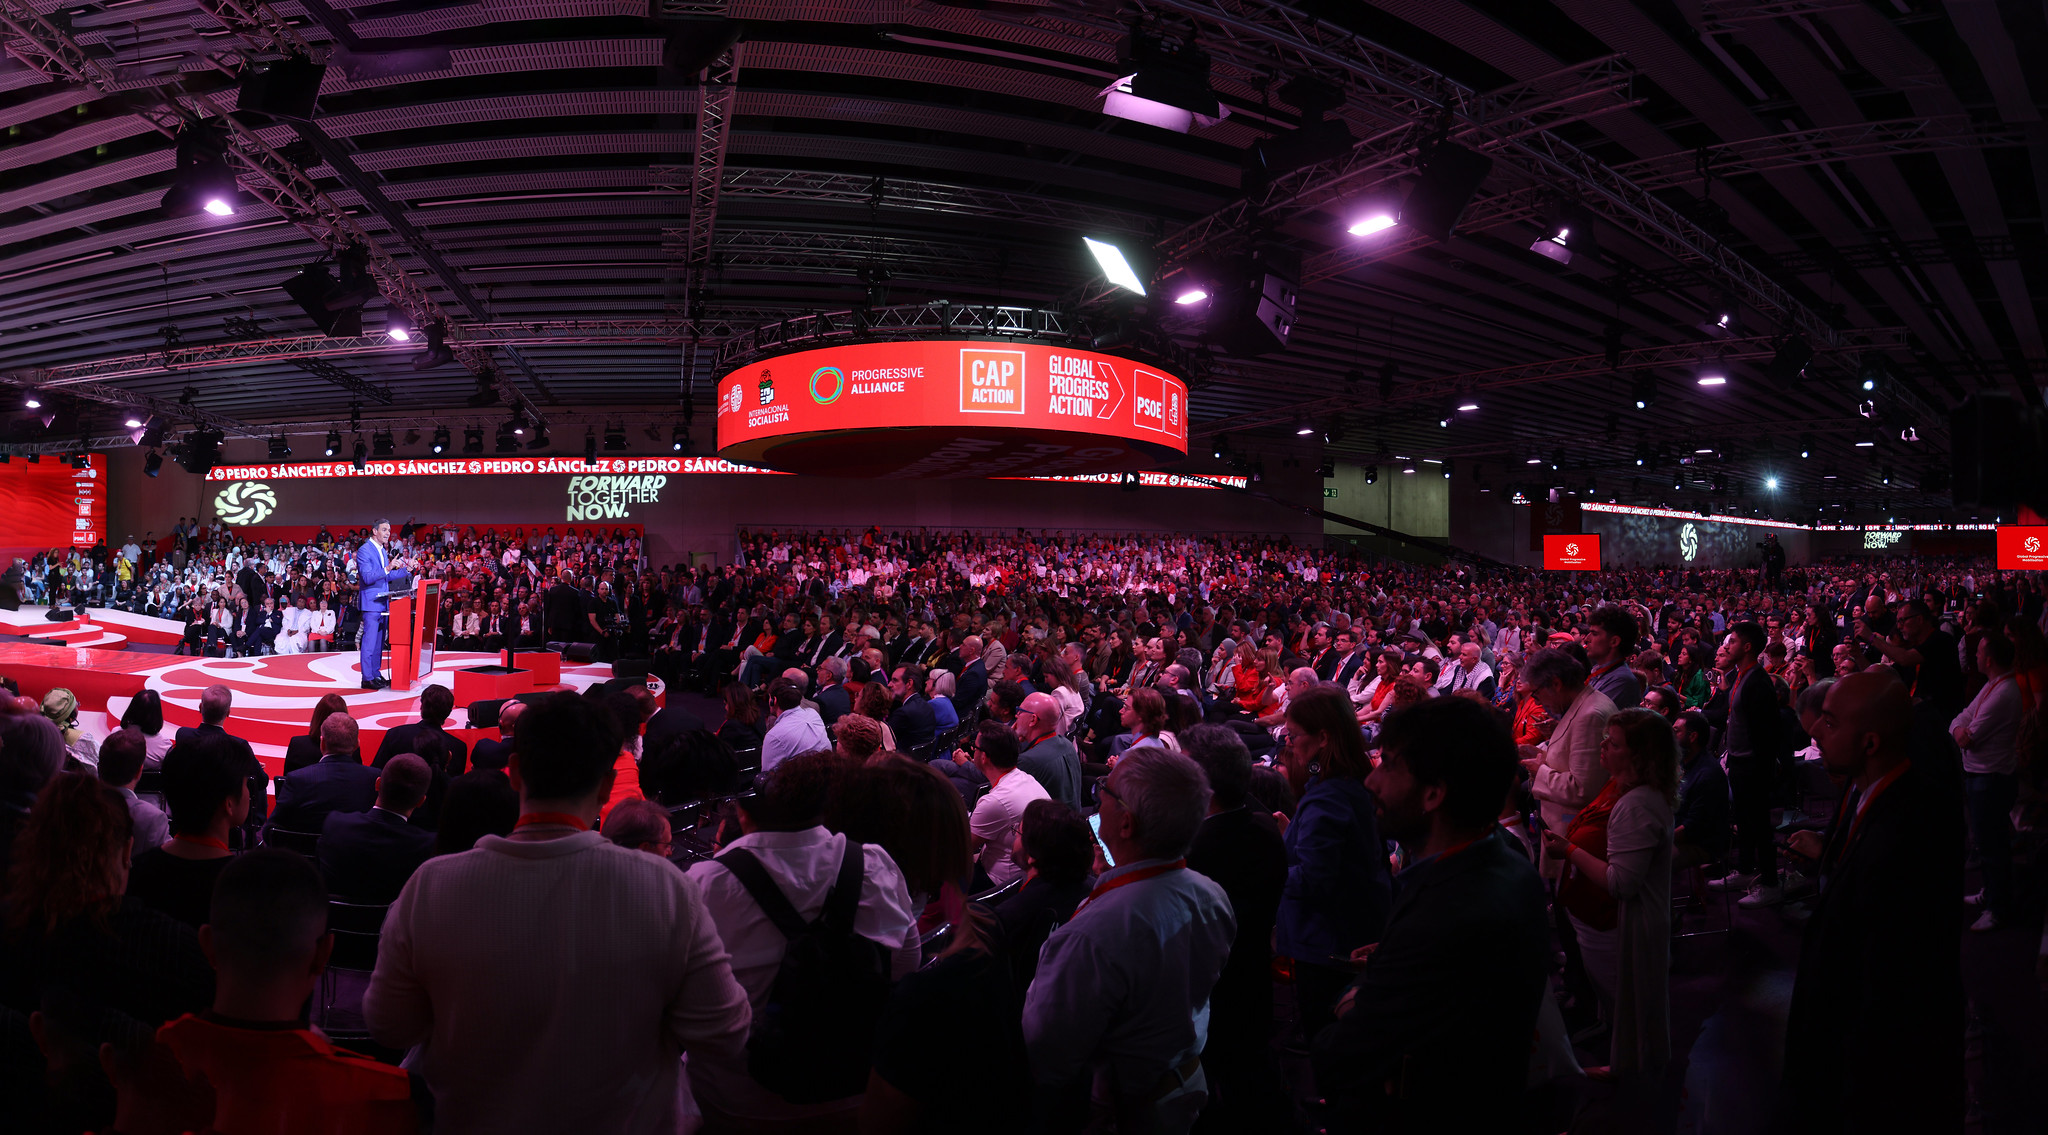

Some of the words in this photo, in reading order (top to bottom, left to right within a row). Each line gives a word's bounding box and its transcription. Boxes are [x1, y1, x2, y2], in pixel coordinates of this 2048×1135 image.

[851, 367, 925, 381] PROGRESSIVE
[971, 359, 1014, 387] CAP
[1049, 355, 1095, 379] GLOBAL
[850, 381, 905, 395] ALLIANCE
[971, 388, 1014, 404] ACTION
[1049, 375, 1109, 400] PROGRESS
[748, 404, 790, 418] INTERNACIONAL
[1048, 395, 1093, 417] ACTION
[1137, 396, 1162, 419] PSOE
[748, 412, 789, 428] SOCIALISTA
[225, 467, 269, 480] PEDRO
[270, 463, 333, 479] SÁNCHEZ
[398, 459, 466, 475] SÁNCHEZ
[483, 461, 534, 473] PEDRO
[628, 460, 681, 472] PEDRO
[567, 475, 667, 491] FORWARD
[567, 489, 659, 506] TOGETHER
[566, 503, 630, 522] NOW.
[1864, 531, 1902, 539] FORWARD
